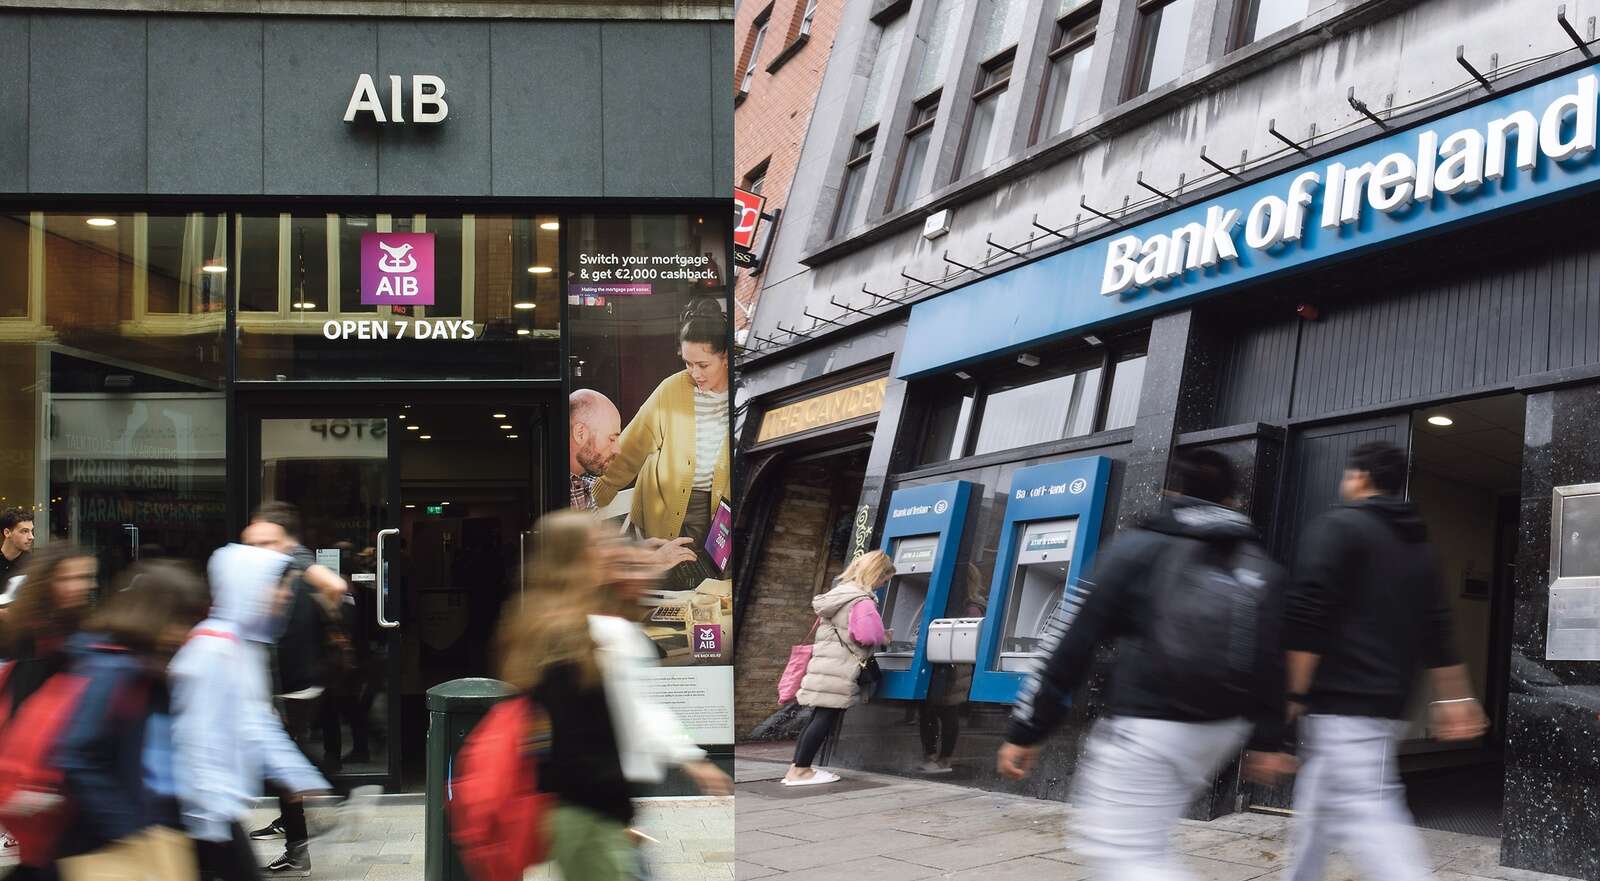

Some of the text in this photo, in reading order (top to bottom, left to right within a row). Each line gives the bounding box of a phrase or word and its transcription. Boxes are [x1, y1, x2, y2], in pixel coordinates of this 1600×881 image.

[343, 73, 449, 123] AIB
[1100, 74, 1599, 297] Bank of Ireland
[580, 253, 709, 267] Switch your mortgage
[580, 268, 718, 281] & get €2,000 cashback.
[375, 276, 419, 296] AIB
[323, 319, 475, 340] OPEN 7 DAYS
[699, 641, 716, 649] AIB
